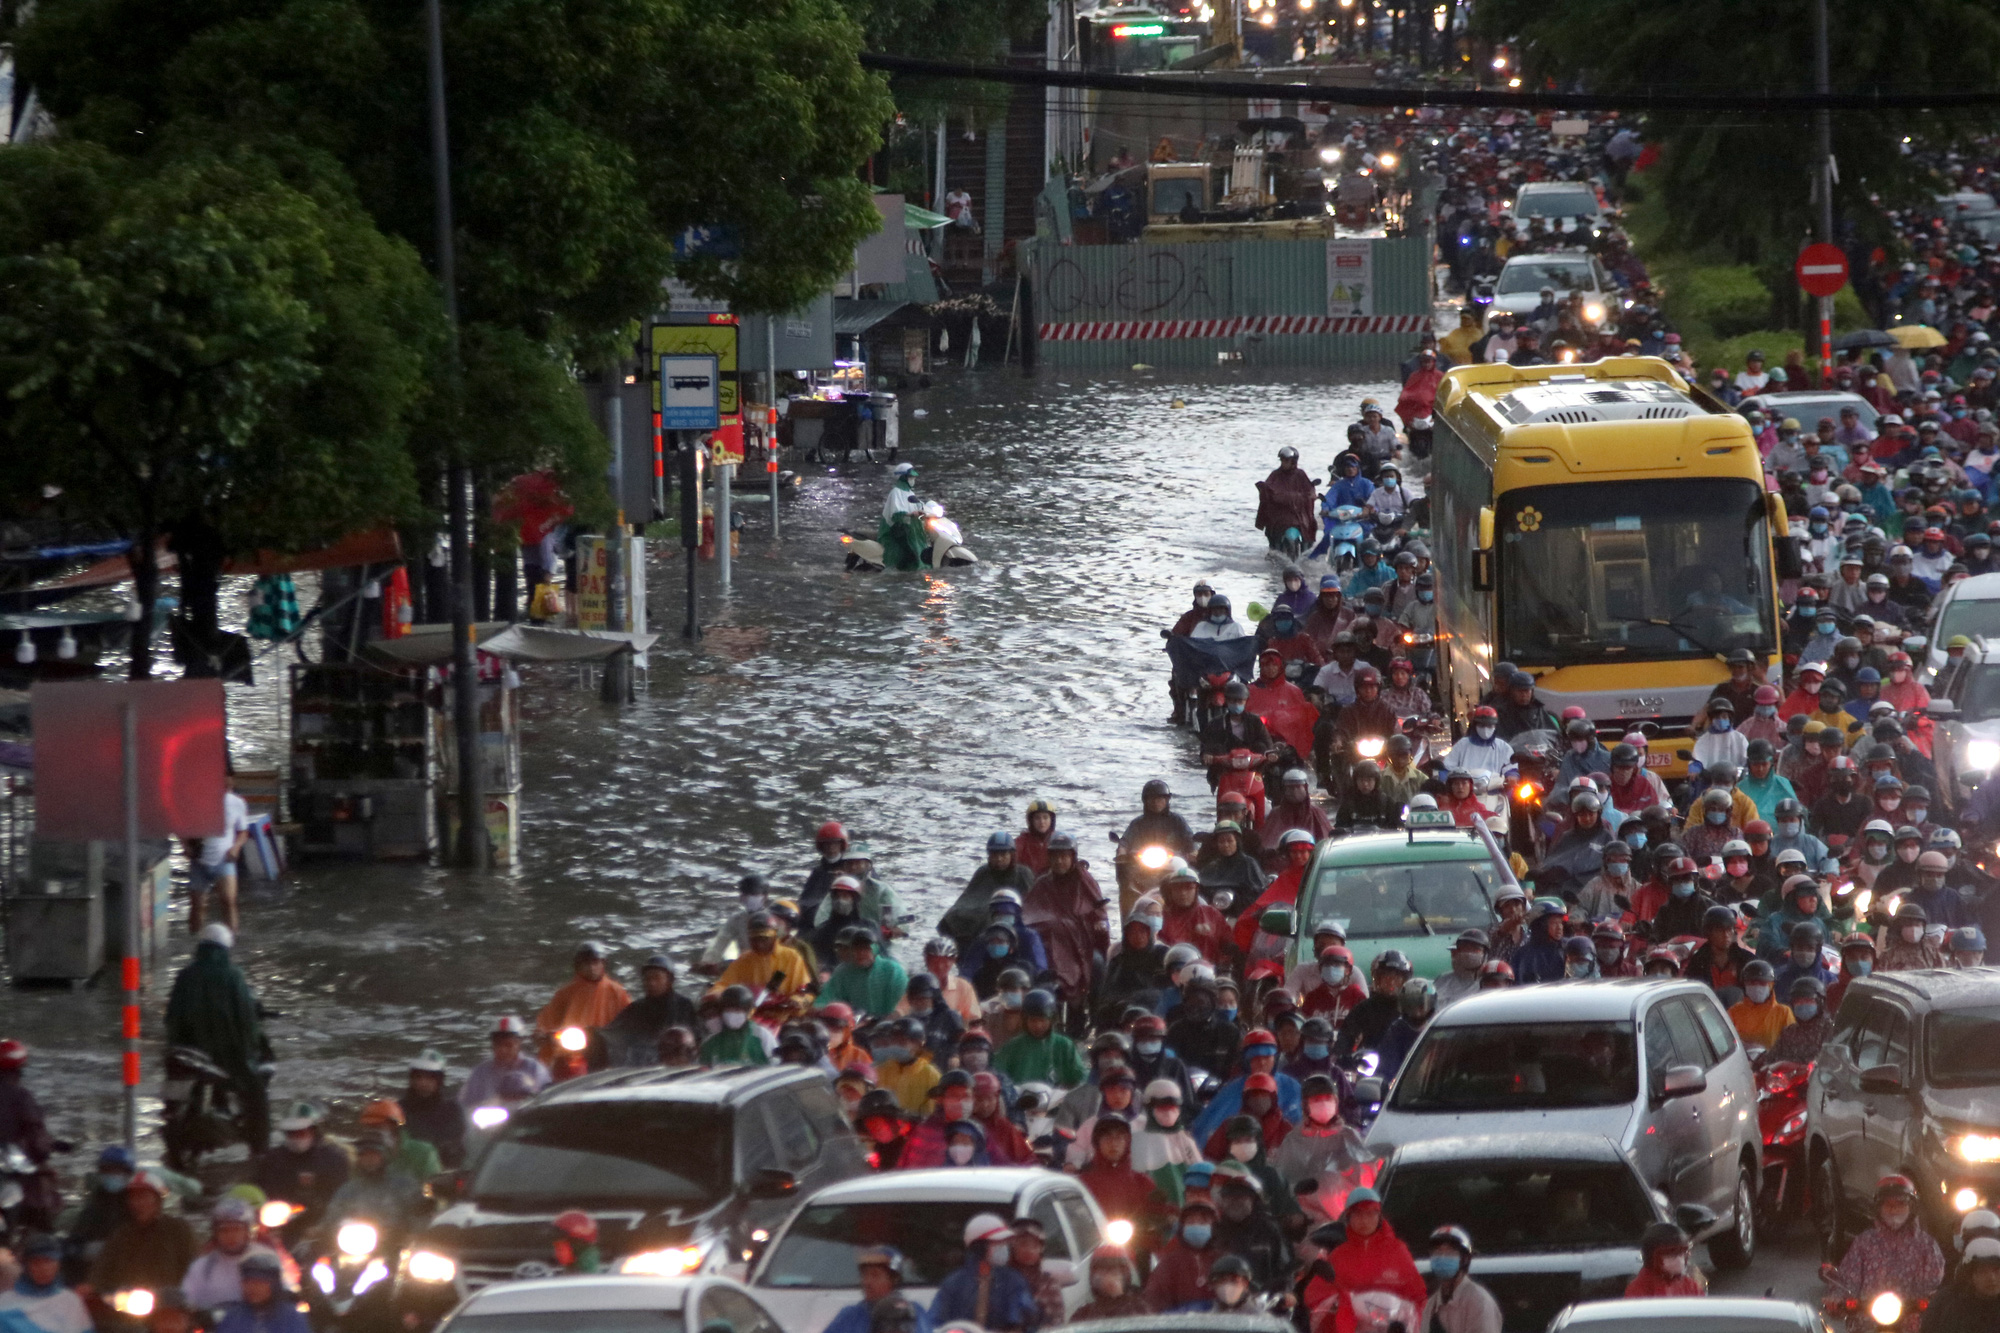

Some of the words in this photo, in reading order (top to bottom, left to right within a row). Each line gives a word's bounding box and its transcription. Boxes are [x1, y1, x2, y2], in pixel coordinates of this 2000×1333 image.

[670, 418, 687, 426] BUS
[689, 418, 710, 426] STOP
[1411, 813, 1448, 824] TAXI
